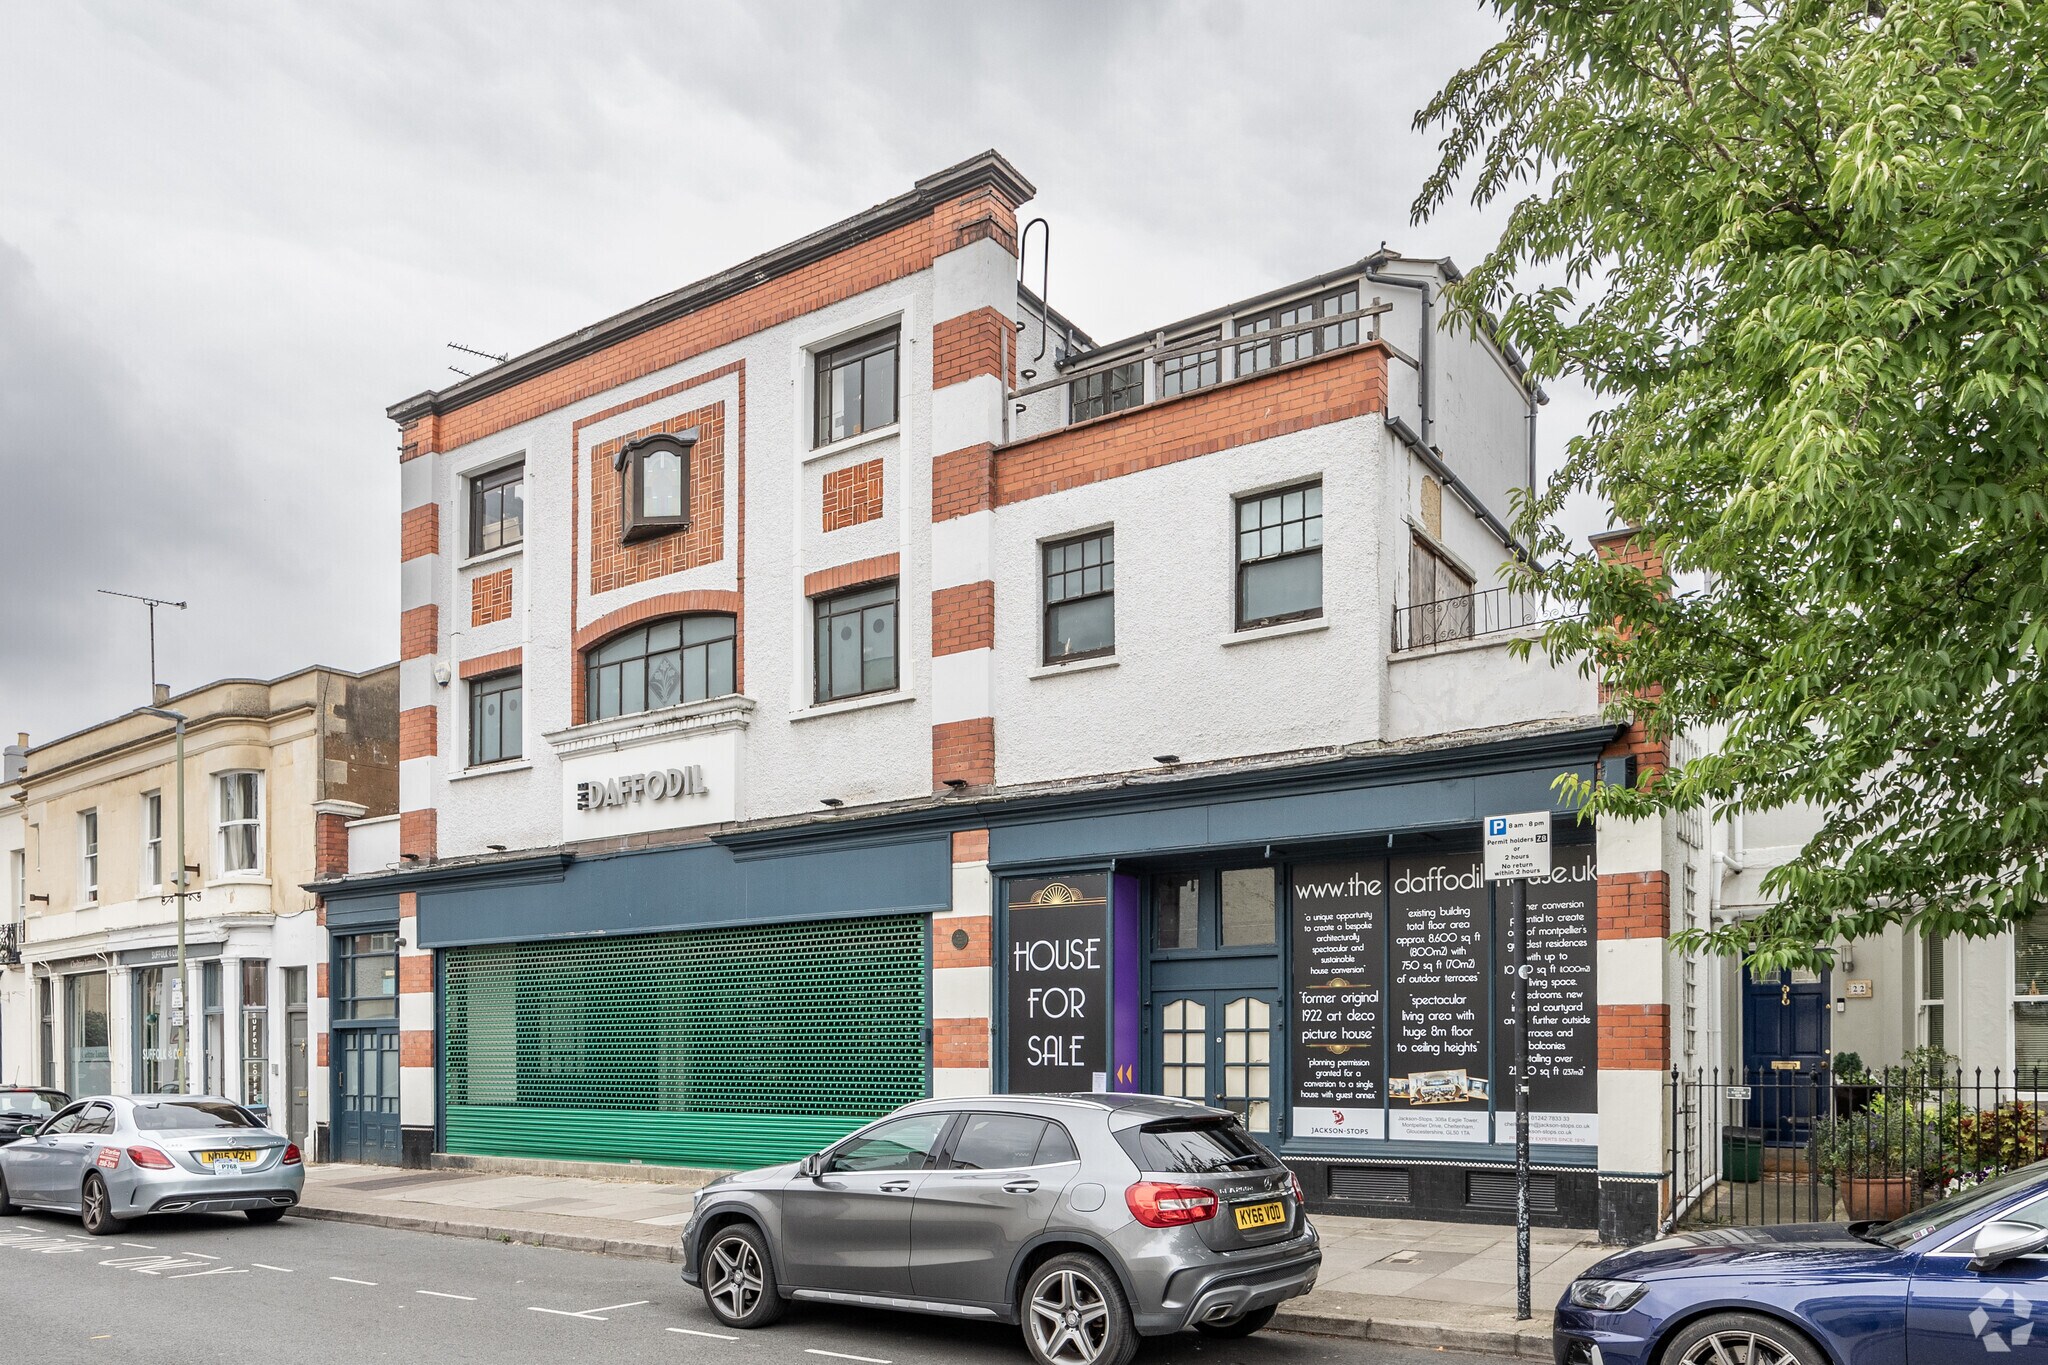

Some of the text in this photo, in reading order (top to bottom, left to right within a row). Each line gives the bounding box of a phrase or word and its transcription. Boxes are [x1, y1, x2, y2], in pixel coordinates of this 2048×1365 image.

[588, 765, 709, 809] DAFFODIL
[1493, 820, 1504, 834] P
[1394, 863, 1484, 894] daffodil
[1295, 872, 1382, 899] www.the
[1542, 900, 1584, 910] conversion
[1313, 914, 1334, 923] unique
[1336, 911, 1373, 921] opportunity
[1439, 906, 1471, 918] building
[1545, 914, 1554, 922] to
[1557, 913, 1585, 923] create
[1345, 922, 1373, 932] bespoke
[1406, 920, 1471, 931] total floor area
[1316, 932, 1360, 943] architecturally
[1396, 937, 1425, 947] approx
[1460, 935, 1471, 945] sq
[1474, 931, 1481, 941] ft
[1545, 937, 1588, 949] residences
[151, 950, 168, 960] SUFFOLK
[1013, 938, 1101, 972] HOUSE
[1312, 943, 1365, 955] spectacular and
[1450, 946, 1467, 955] with
[1320, 955, 1356, 964] sustainable
[1526, 952, 1541, 961] with
[1545, 954, 1556, 963] up
[1310, 967, 1329, 975] house
[1401, 960, 1420, 970] 750
[1422, 962, 1433, 972] sq
[1436, 960, 1443, 969] ft
[1536, 967, 1547, 976] sq
[1549, 964, 1556, 973] ft
[1396, 974, 1407, 984] of
[1408, 973, 1441, 984] outdoor
[1529, 978, 1548, 989] living
[1027, 987, 1086, 1019] FOR
[1341, 990, 1379, 1007] original
[1542, 1002, 1583, 1014] courtyard
[1302, 1008, 1376, 1022] 1922 art deco
[1402, 1010, 1475, 1024] living area with
[1532, 1015, 1558, 1025] further
[1562, 1015, 1591, 1024] outside
[1302, 1028, 1338, 1043] picture
[1403, 1026, 1473, 1040] huge 8m floor
[1556, 1028, 1574, 1037] and
[1027, 1035, 1085, 1067] SALE
[1397, 1043, 1408, 1052] to
[1411, 1041, 1440, 1056] ceiling
[1528, 1041, 1566, 1050] balconies
[142, 1048, 167, 1061] SUFFOLK
[1337, 1059, 1370, 1068] permission
[1315, 1070, 1342, 1079] granted
[1540, 1068, 1550, 1079] sq
[1553, 1066, 1559, 1076] ft
[1355, 1080, 1374, 1090] single
[1300, 1090, 1319, 1098] house
[1320, 1090, 1334, 1098] with
[1335, 1091, 1353, 1101] guest
[1240, 1204, 1281, 1226] KY66 VOD
